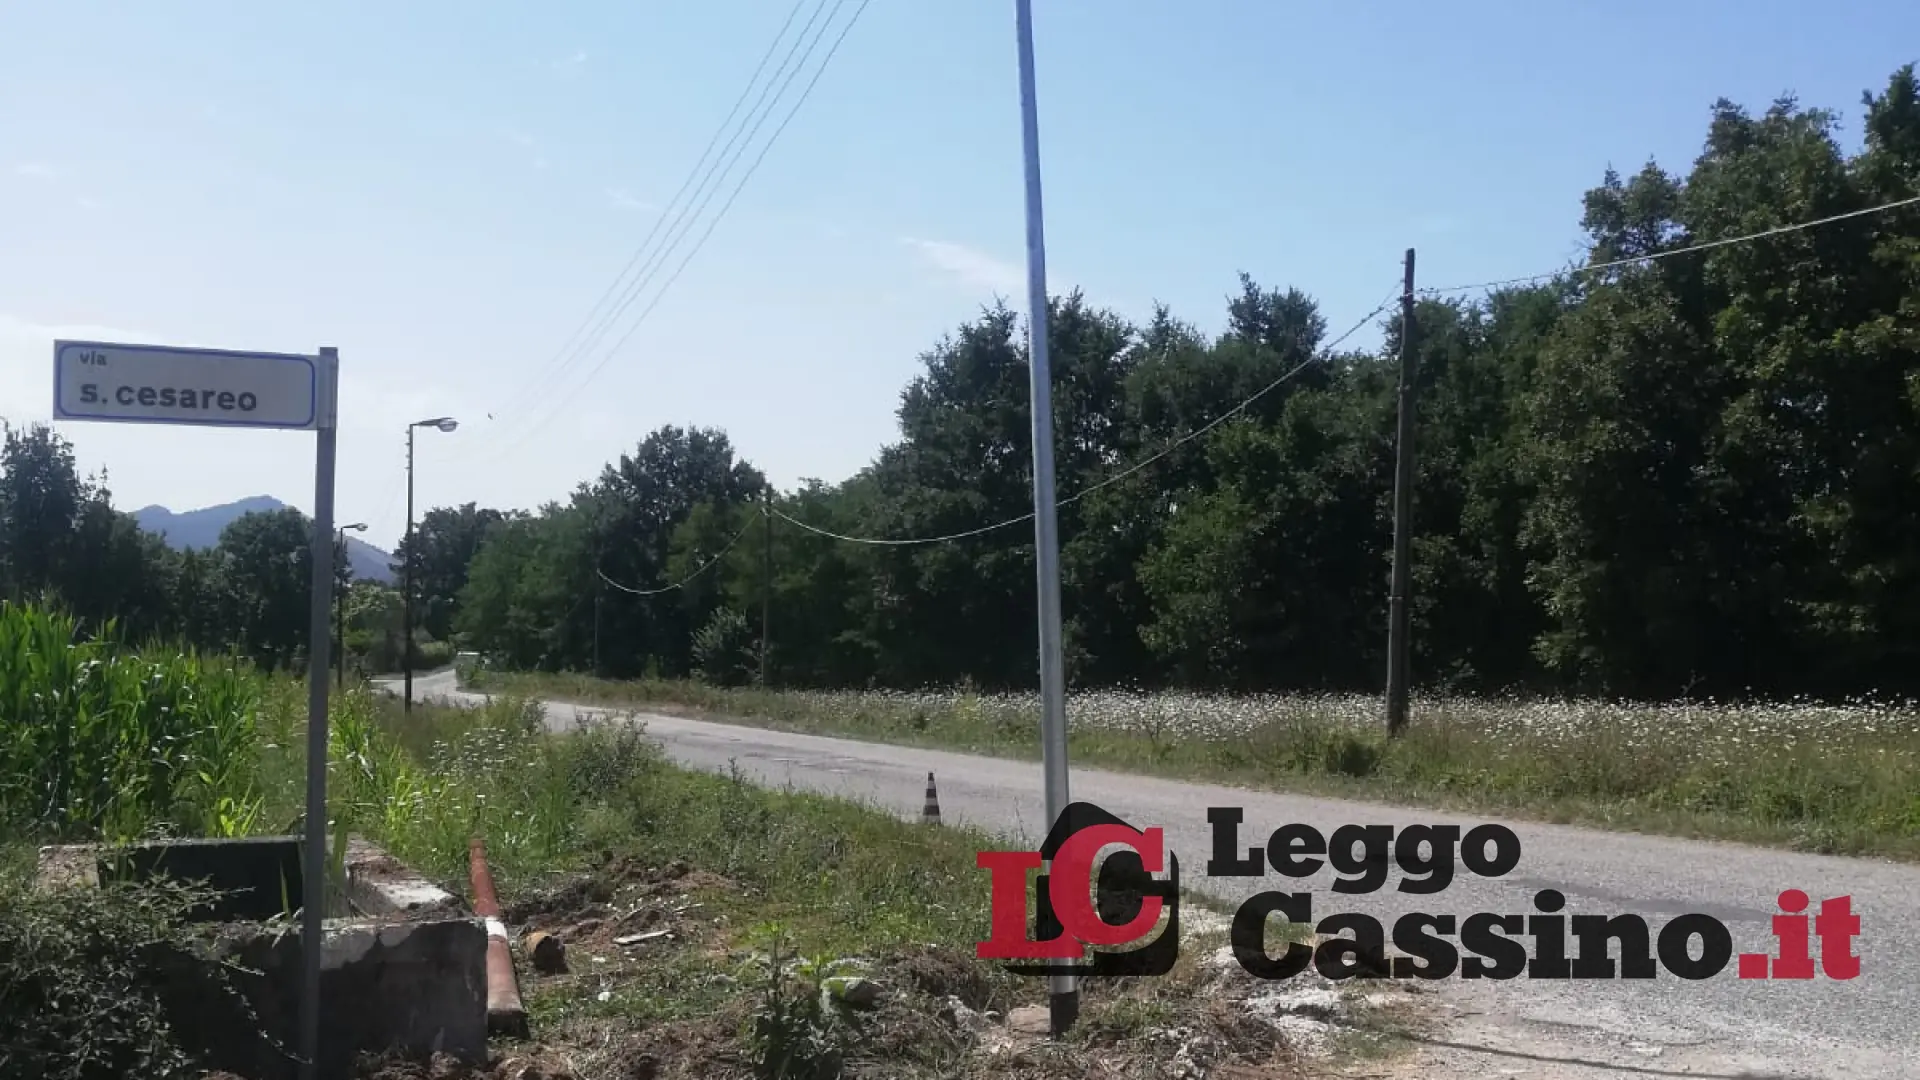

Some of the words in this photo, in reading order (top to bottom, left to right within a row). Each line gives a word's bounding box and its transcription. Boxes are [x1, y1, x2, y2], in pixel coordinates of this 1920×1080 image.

[80, 350, 107, 366] via
[80, 383, 108, 405] s.
[116, 385, 257, 411] cesareo
